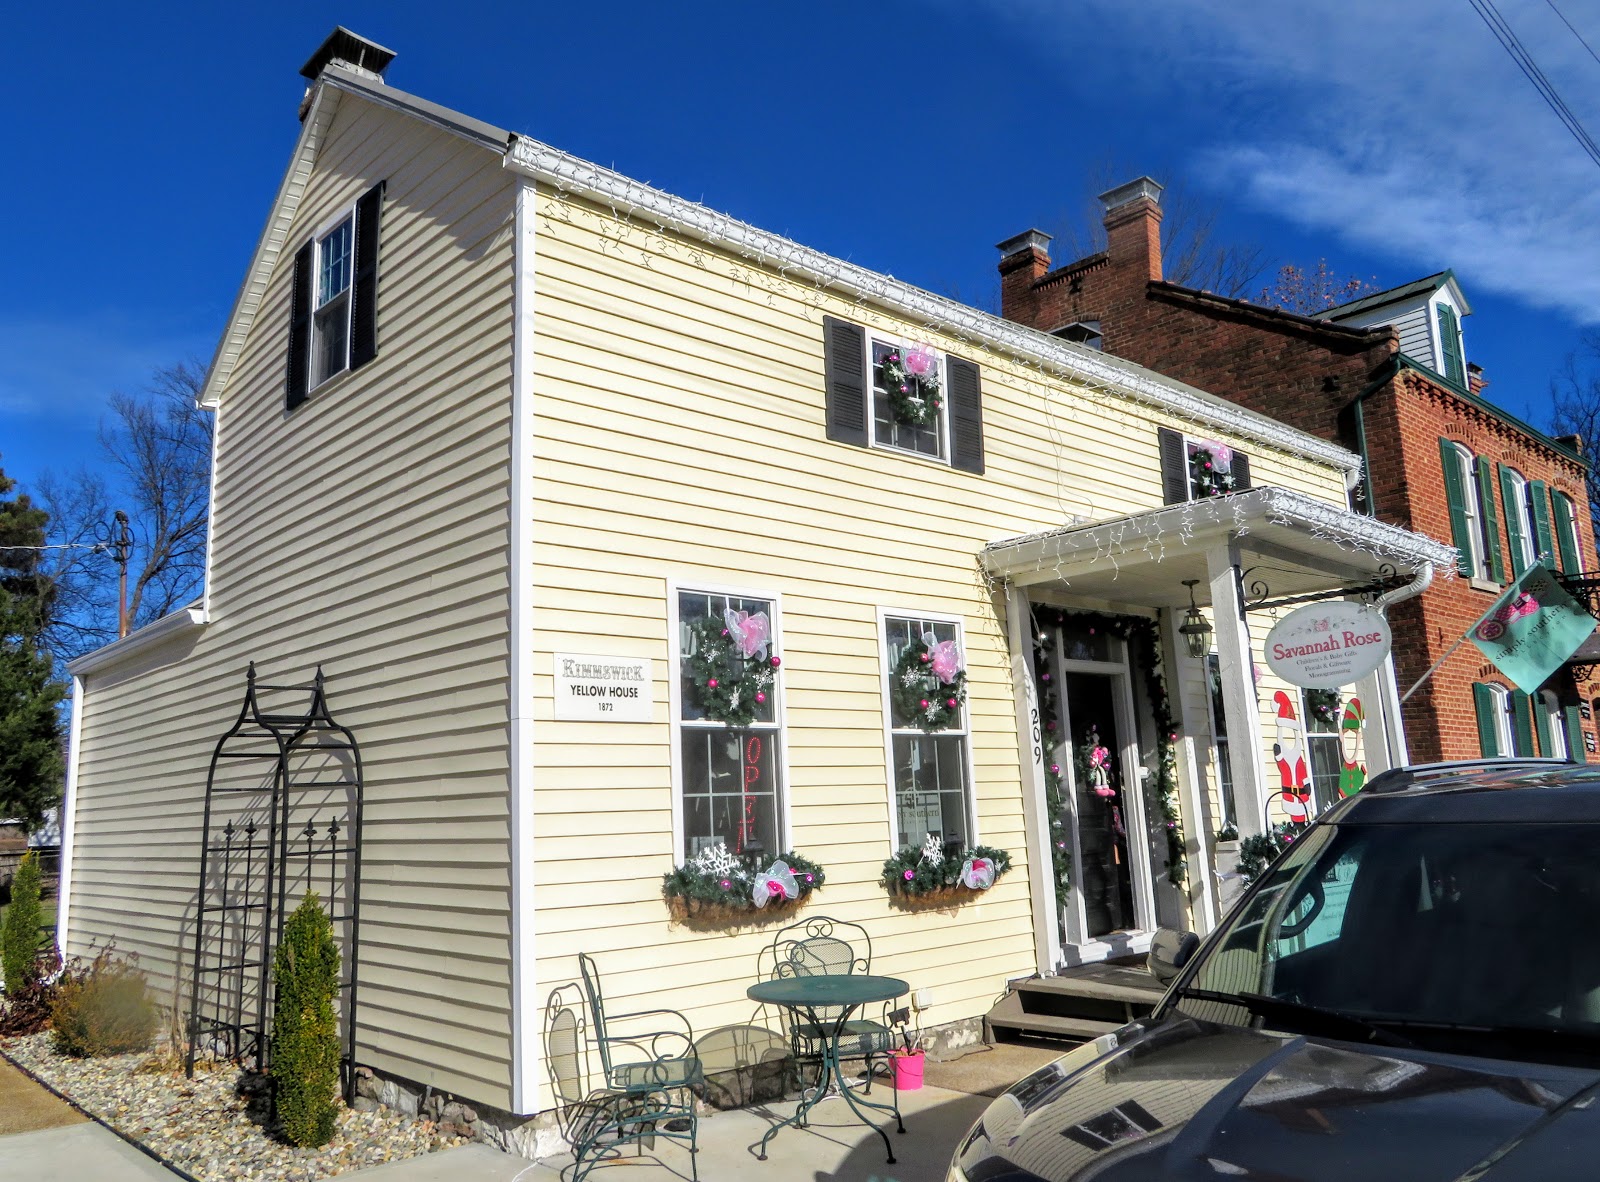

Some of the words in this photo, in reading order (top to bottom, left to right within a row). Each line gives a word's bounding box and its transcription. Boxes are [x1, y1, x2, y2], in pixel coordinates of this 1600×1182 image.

[1273, 634, 1341, 661] Savannah
[1342, 630, 1382, 649] Rose
[1495, 637, 1526, 662] simply
[1527, 602, 1568, 637] southern
[570, 684, 607, 697] YELLOW
[609, 686, 639, 698] HOUSE
[598, 702, 613, 711] 1872
[1031, 708, 1042, 765] 209
